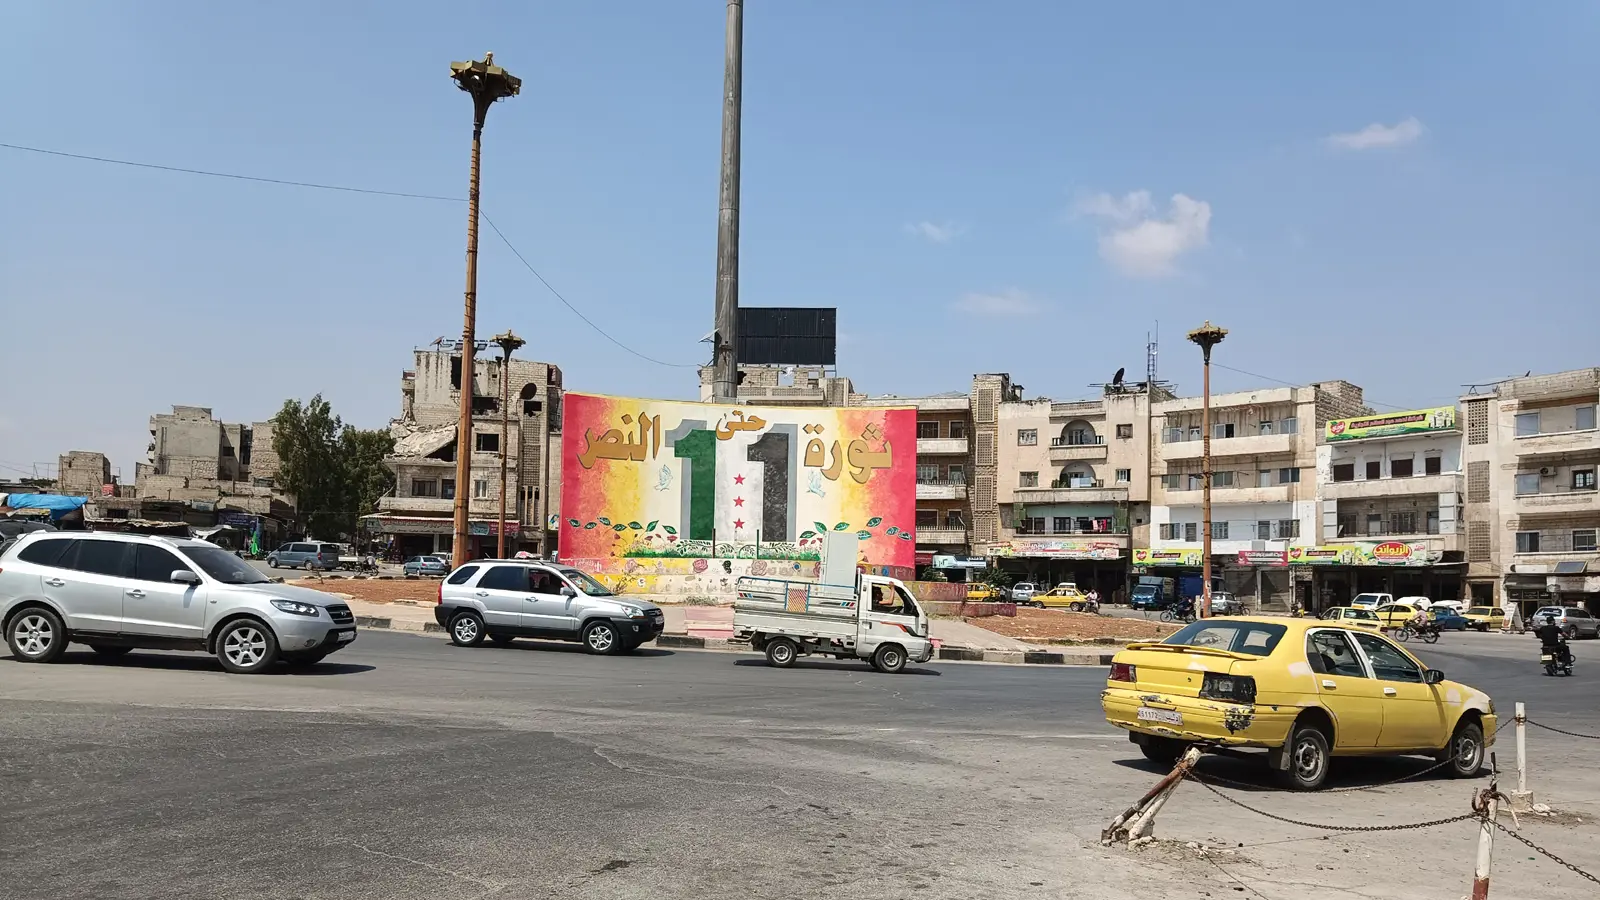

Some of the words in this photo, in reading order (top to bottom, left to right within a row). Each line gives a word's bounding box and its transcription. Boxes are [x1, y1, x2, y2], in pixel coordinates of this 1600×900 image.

[576, 411, 661, 469] النصر
[803, 422, 893, 484] ثورة
[665, 419, 799, 542] 11
